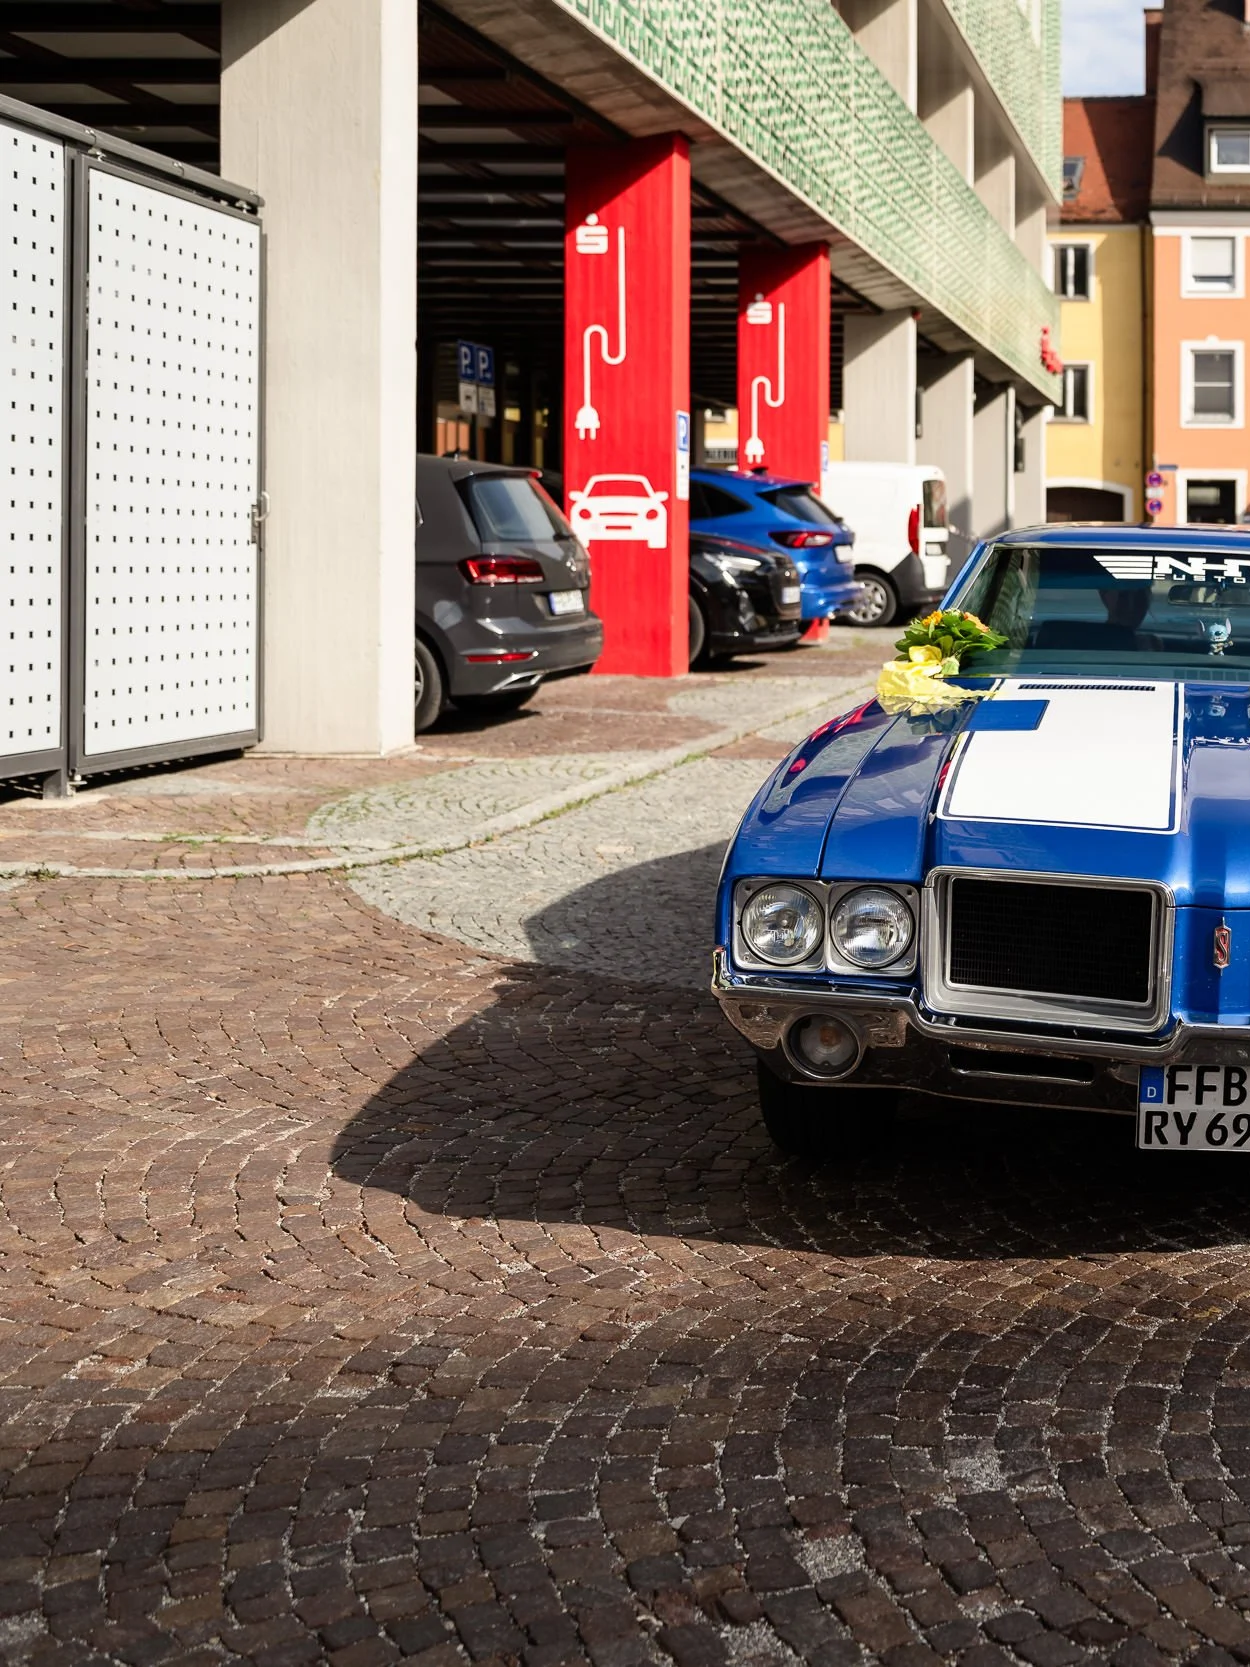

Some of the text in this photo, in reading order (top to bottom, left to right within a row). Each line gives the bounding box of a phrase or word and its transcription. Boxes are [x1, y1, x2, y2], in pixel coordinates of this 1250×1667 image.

[461, 346, 471, 374] P
[479, 351, 489, 377] P
[1147, 1065, 1247, 1106] D FFB
[1144, 1111, 1197, 1145] RY
